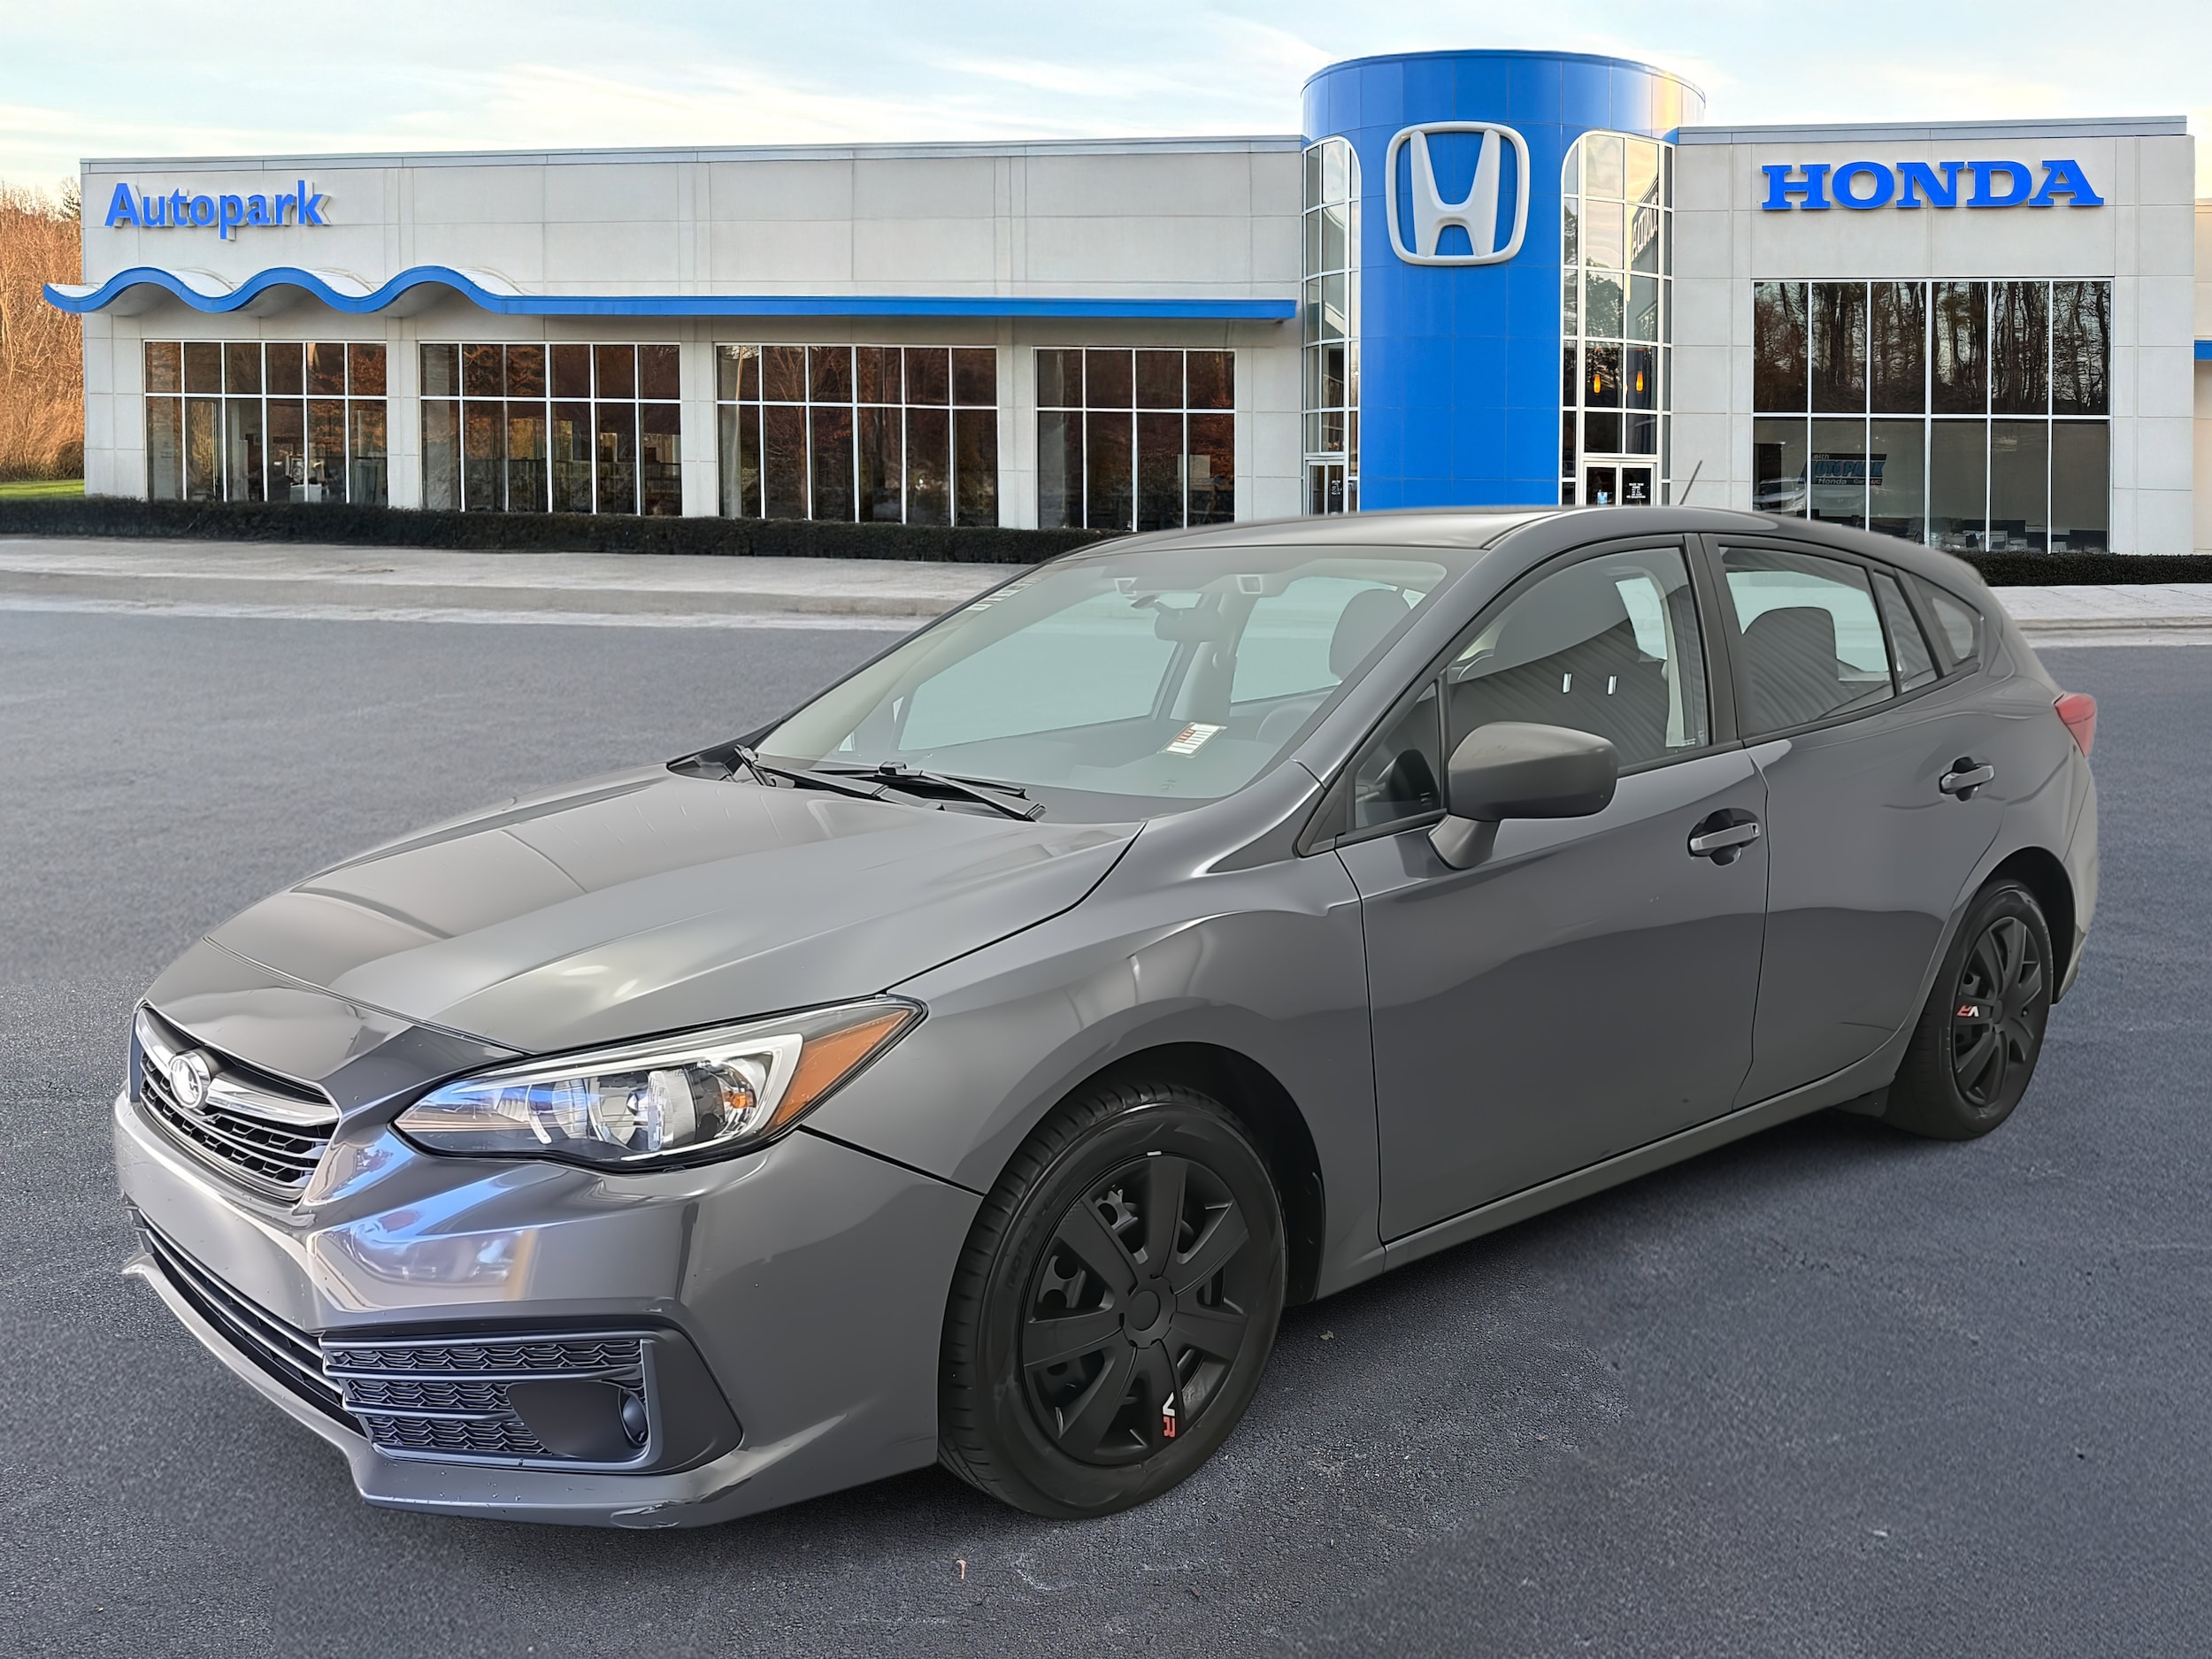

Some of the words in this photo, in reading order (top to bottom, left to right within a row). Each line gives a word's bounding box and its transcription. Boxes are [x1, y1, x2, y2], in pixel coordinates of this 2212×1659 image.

[104, 180, 327, 240] Autopark
[1761, 159, 2105, 211] HONDA
[1162, 1391, 1176, 1438] VR
